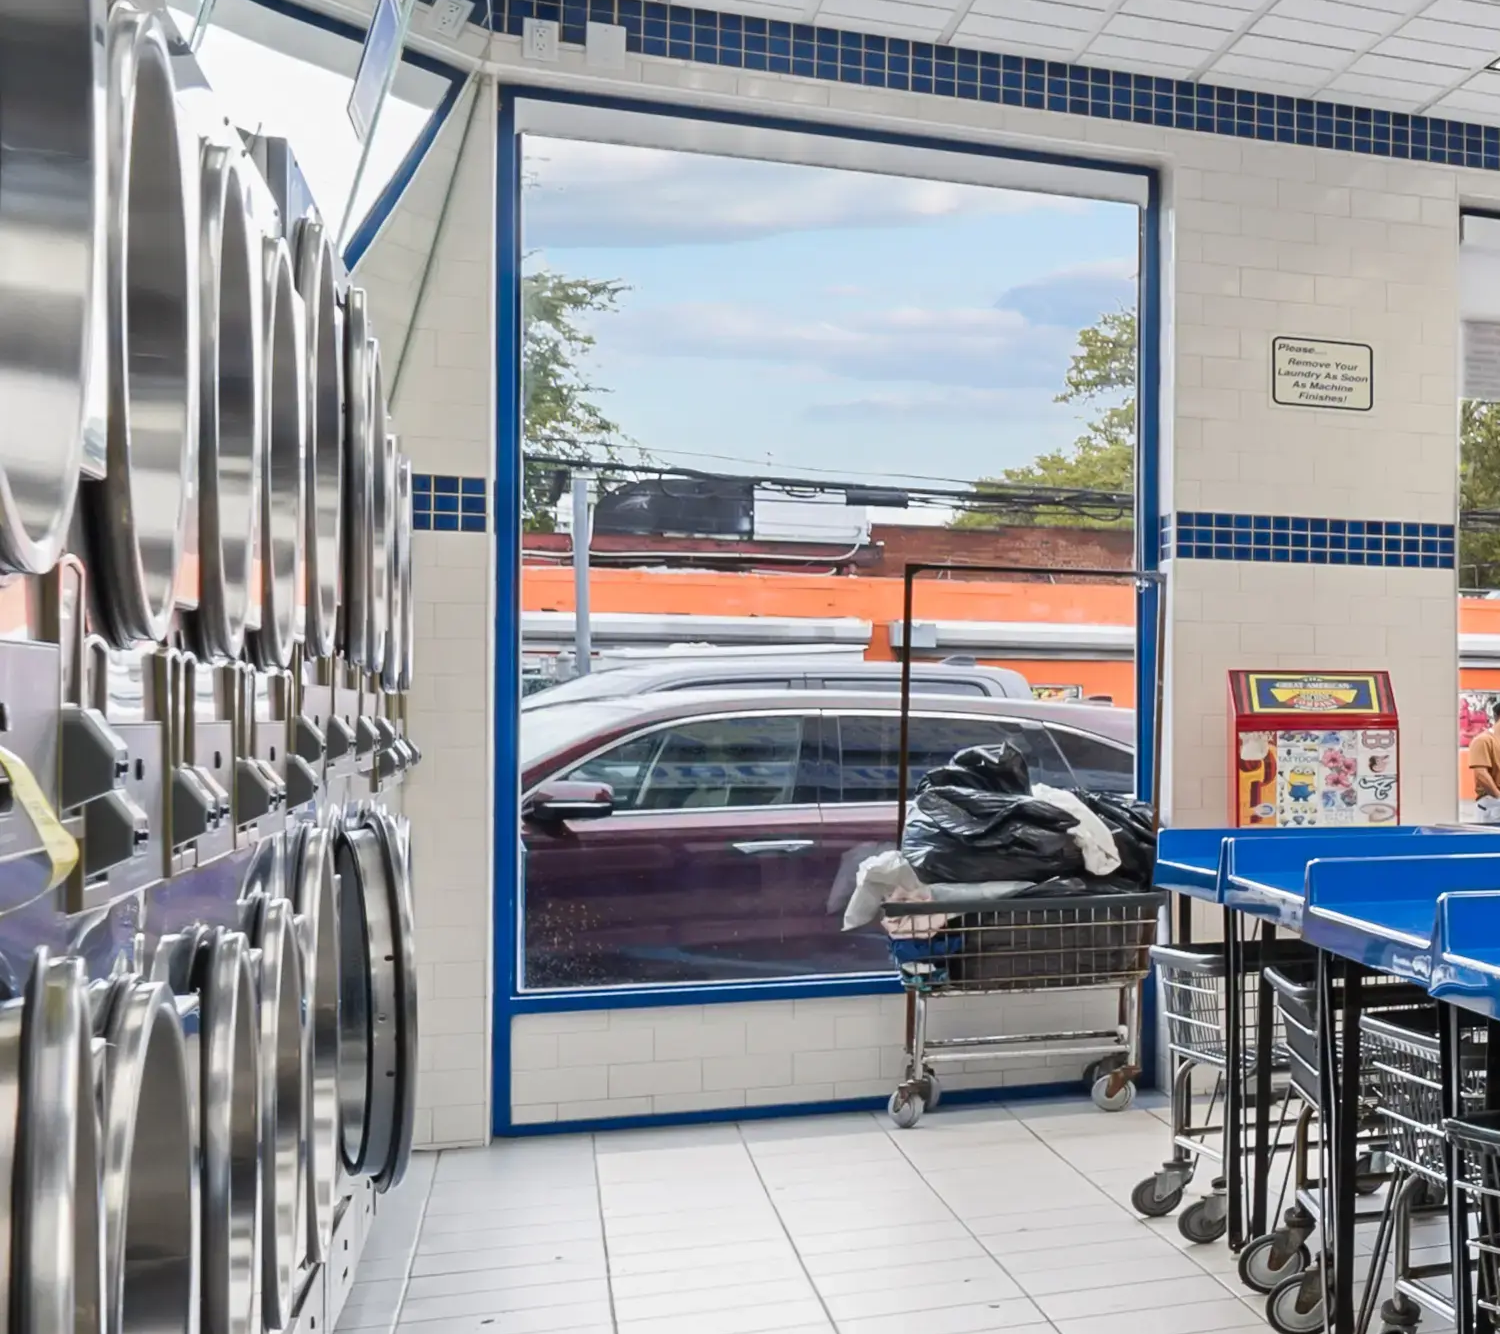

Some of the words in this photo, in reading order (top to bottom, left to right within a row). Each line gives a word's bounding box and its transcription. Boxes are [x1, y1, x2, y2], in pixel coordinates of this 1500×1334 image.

[1288, 357, 1331, 369] Remove
[1335, 361, 1359, 371] Your
[1278, 368, 1321, 380] Laundry
[1323, 372, 1338, 380] As
[1340, 373, 1368, 383] Soon
[1292, 380, 1307, 389] As
[1309, 382, 1354, 393] Machine
[1298, 391, 1348, 404] Finishes!
